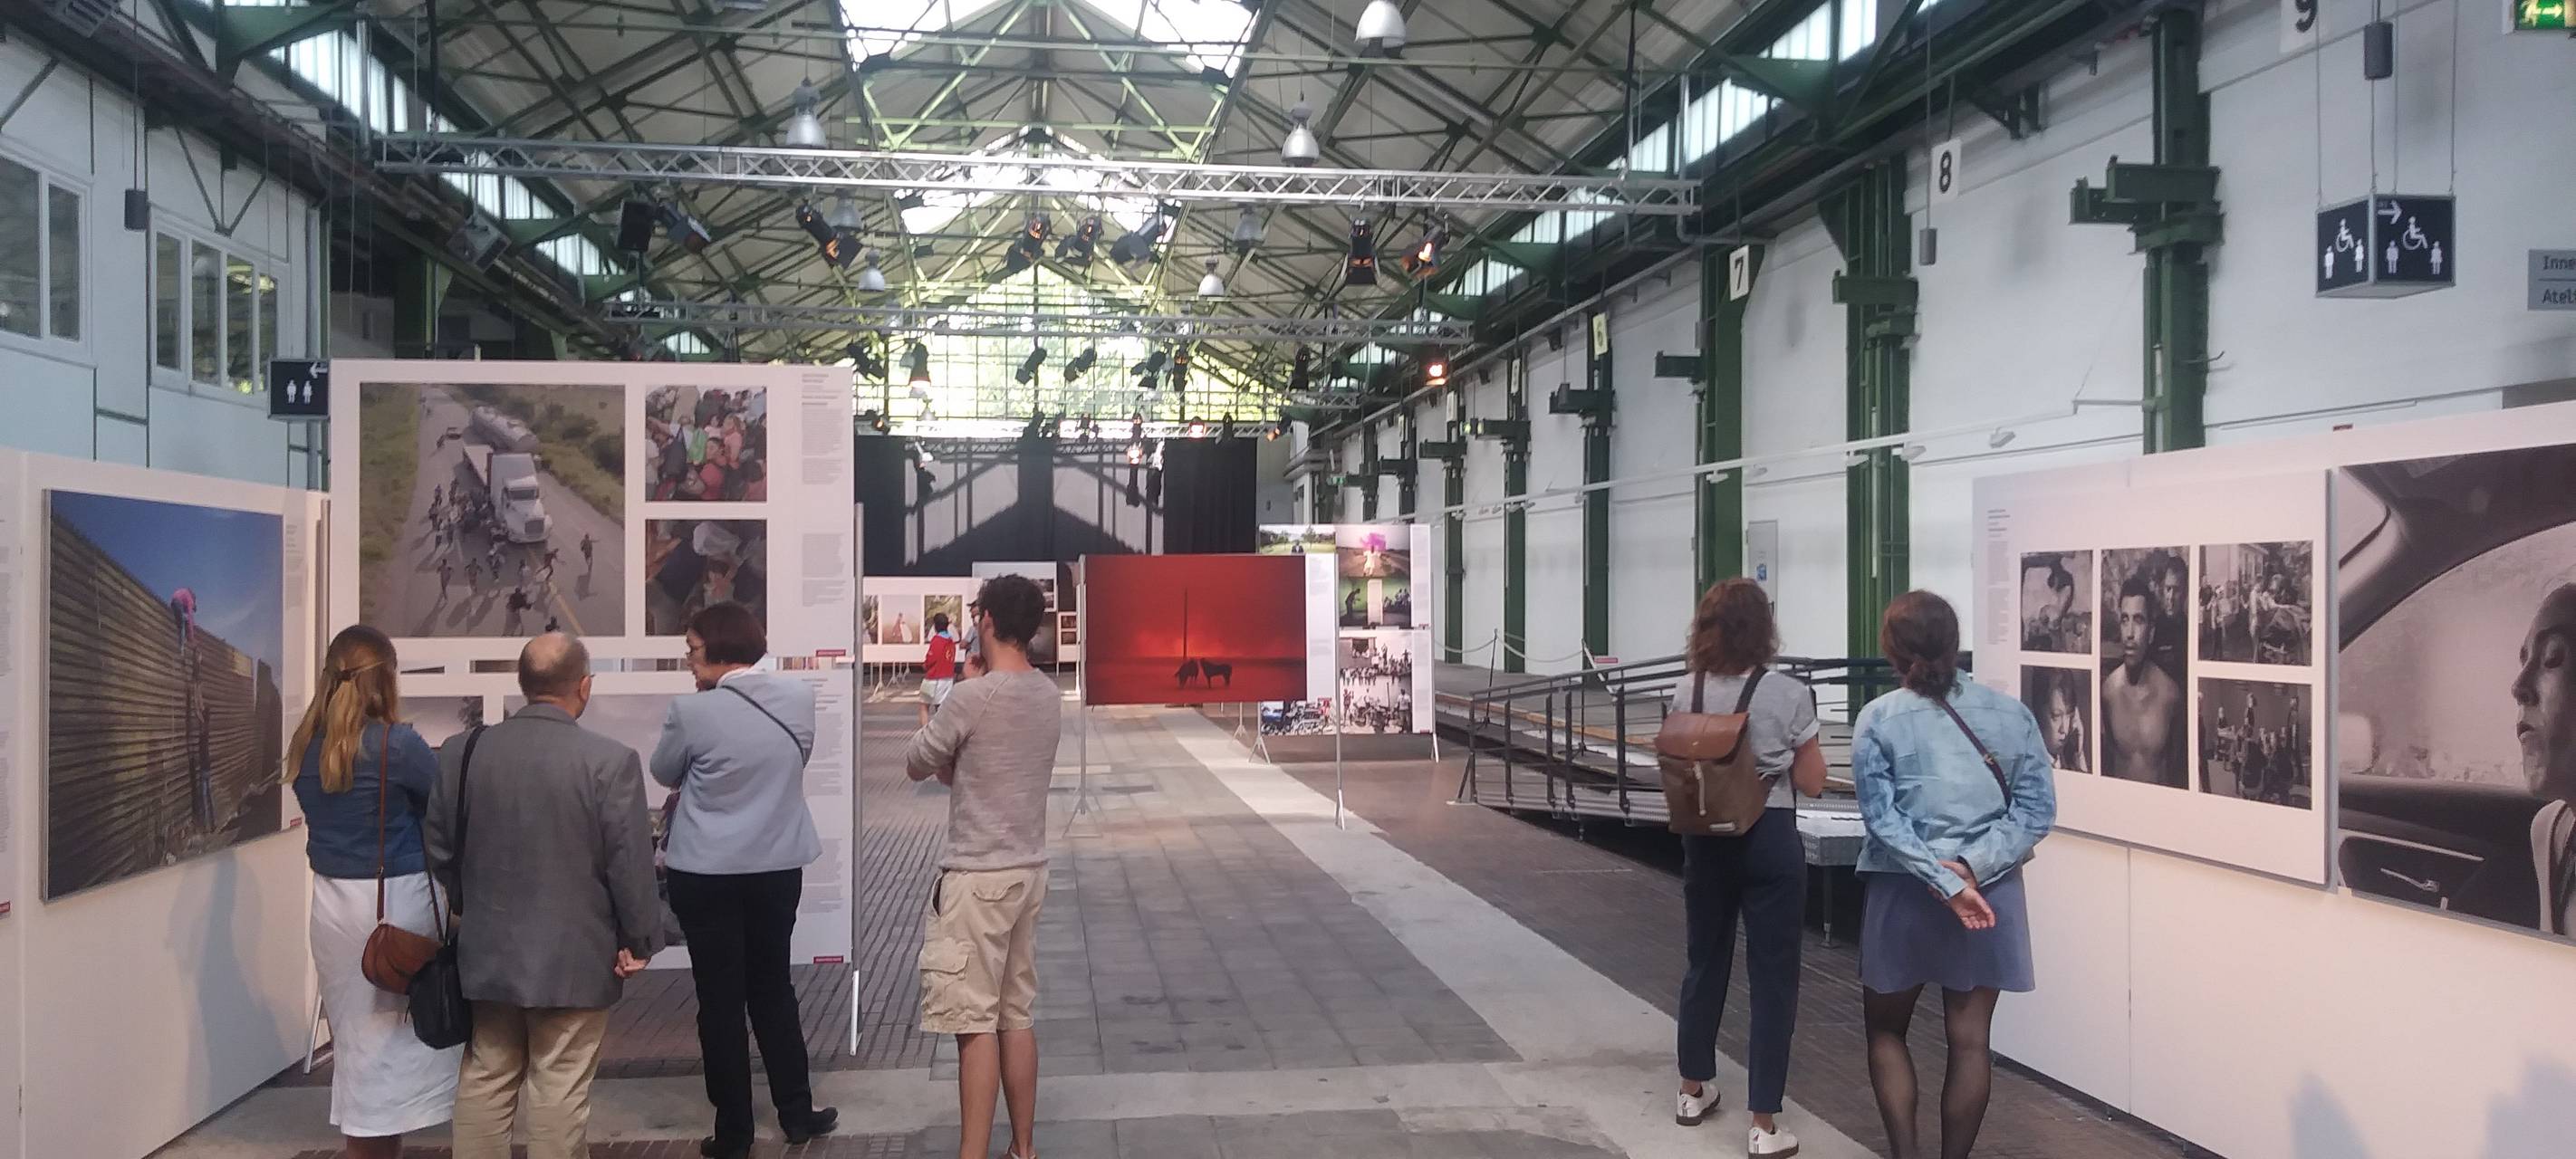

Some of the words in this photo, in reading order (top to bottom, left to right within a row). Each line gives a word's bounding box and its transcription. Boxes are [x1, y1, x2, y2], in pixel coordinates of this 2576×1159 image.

[2295, 0, 2318, 33] 9
[1939, 150, 1952, 194] 8
[1735, 255, 1744, 291] 7
[1597, 321, 1603, 348] 6
